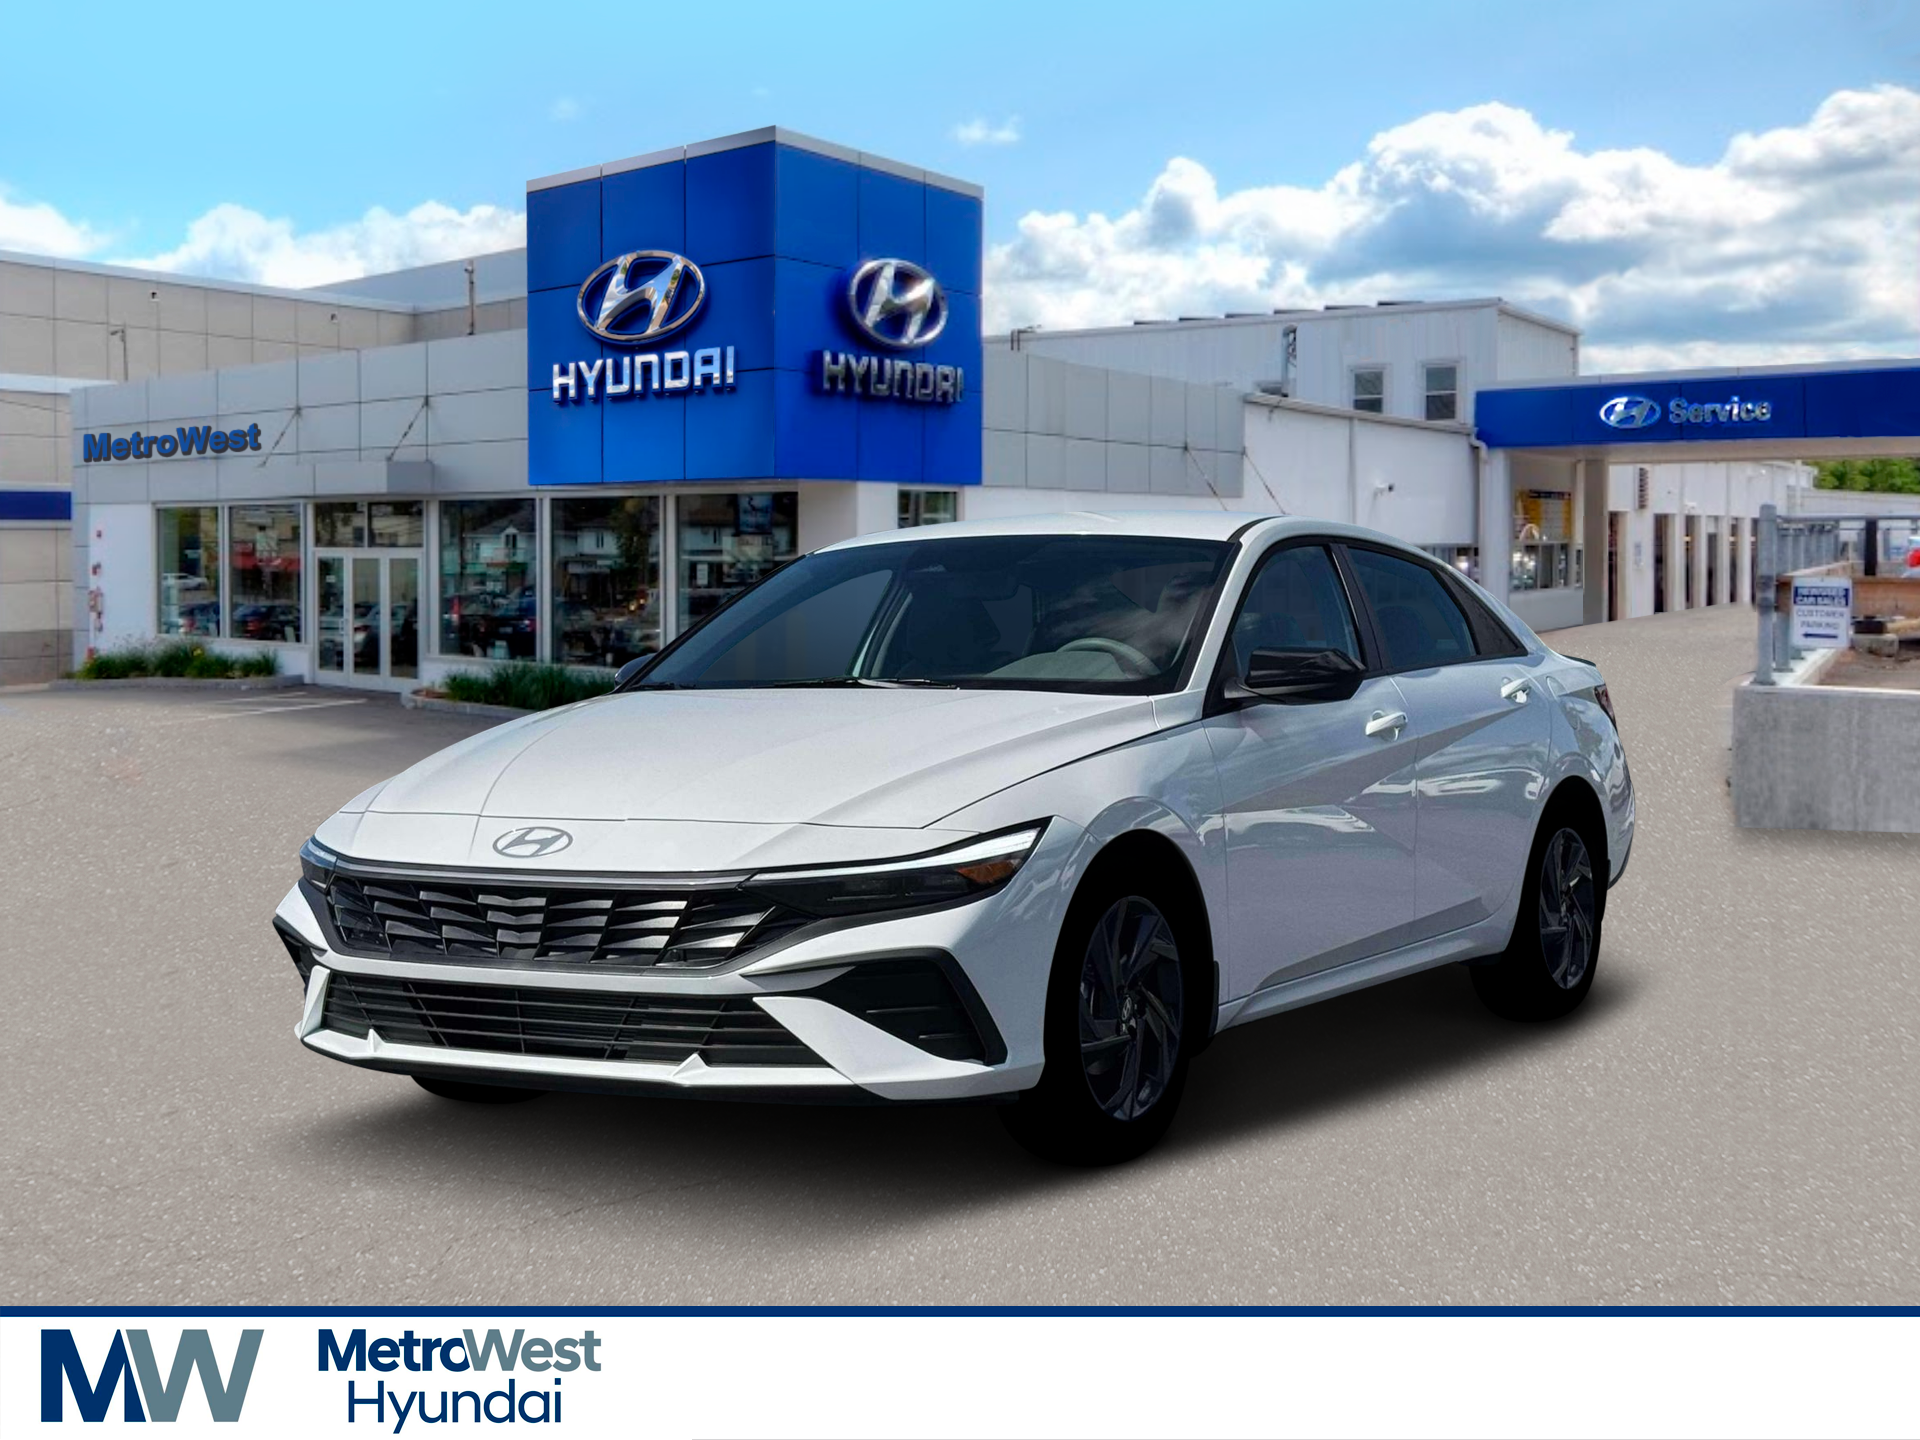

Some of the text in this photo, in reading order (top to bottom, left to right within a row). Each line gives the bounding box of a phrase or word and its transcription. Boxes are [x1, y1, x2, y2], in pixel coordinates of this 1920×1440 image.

[552, 345, 736, 402] HYUNDAI
[821, 349, 964, 403] HYUNDAI
[1668, 396, 1772, 424] Service
[83, 423, 262, 463] MetroWest
